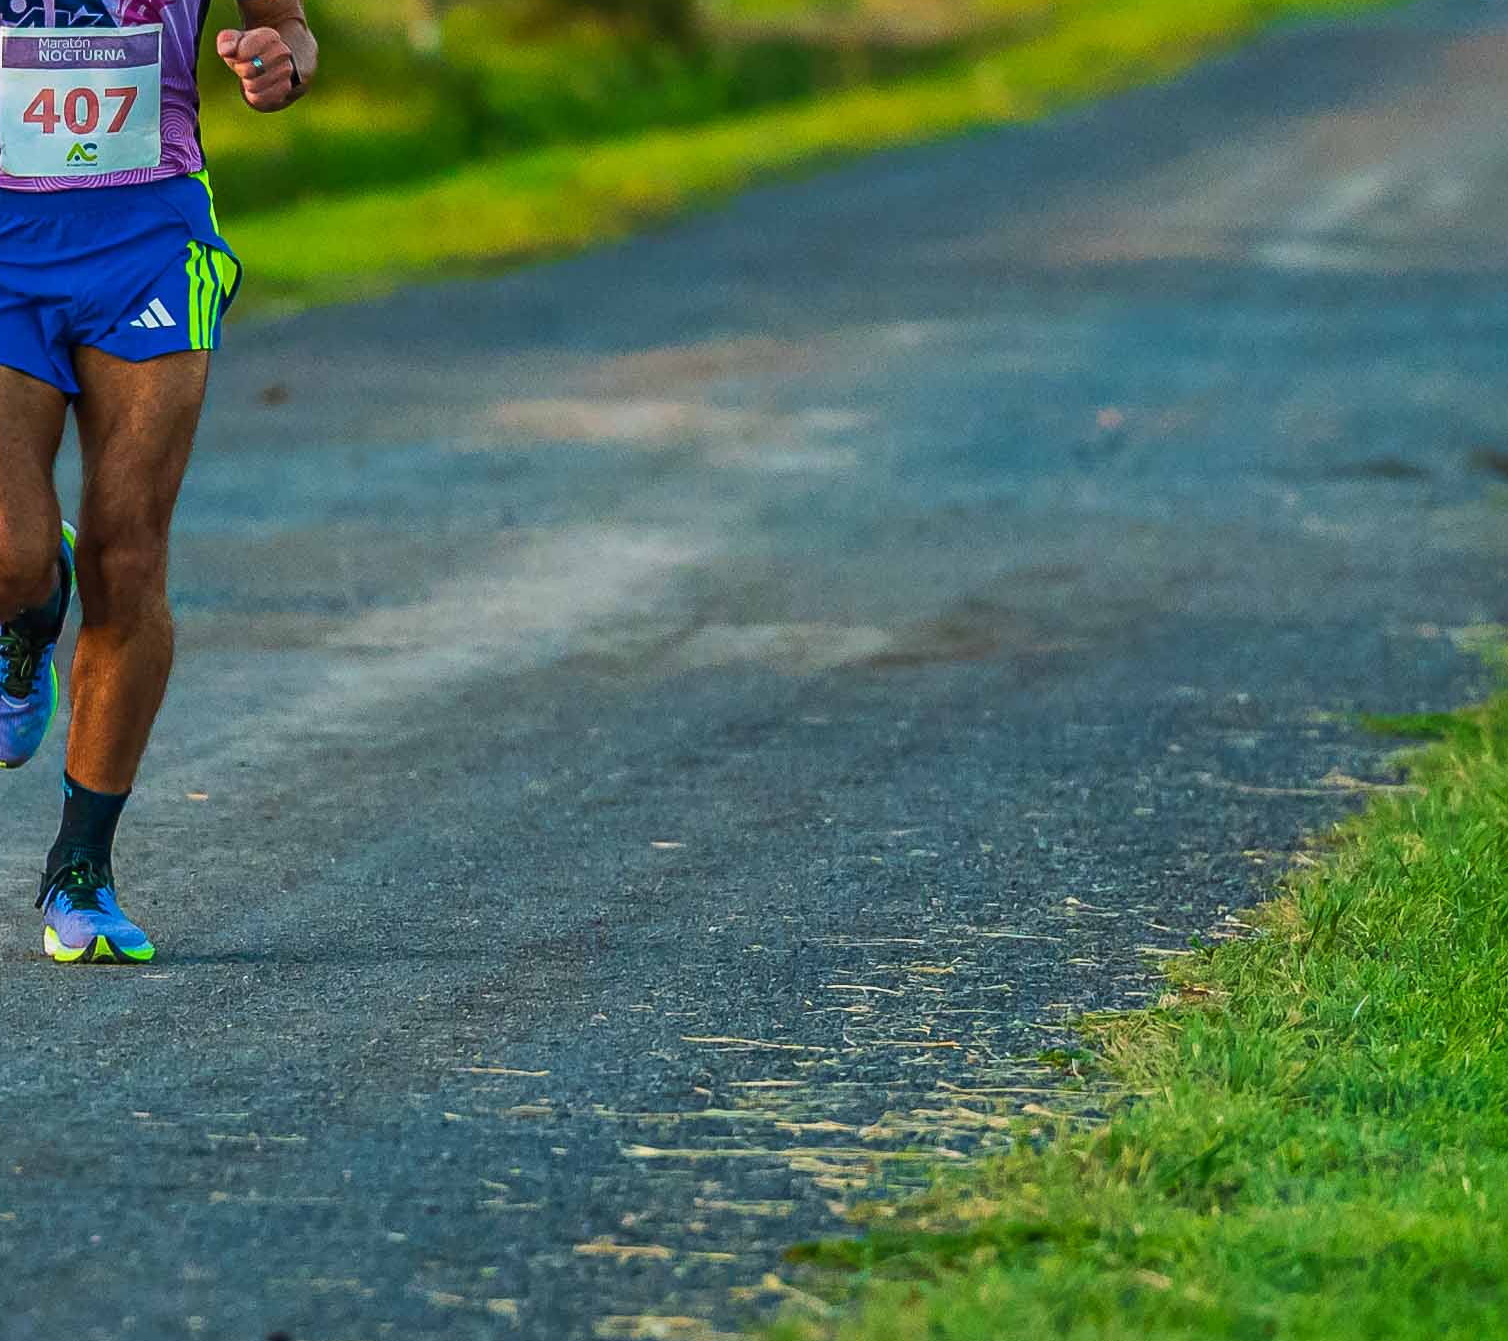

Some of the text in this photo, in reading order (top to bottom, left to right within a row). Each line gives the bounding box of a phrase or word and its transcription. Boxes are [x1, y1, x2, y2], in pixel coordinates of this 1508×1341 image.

[39, 37, 90, 49] Maratón
[39, 49, 127, 62] NOCTURNA
[23, 87, 138, 135] 407
